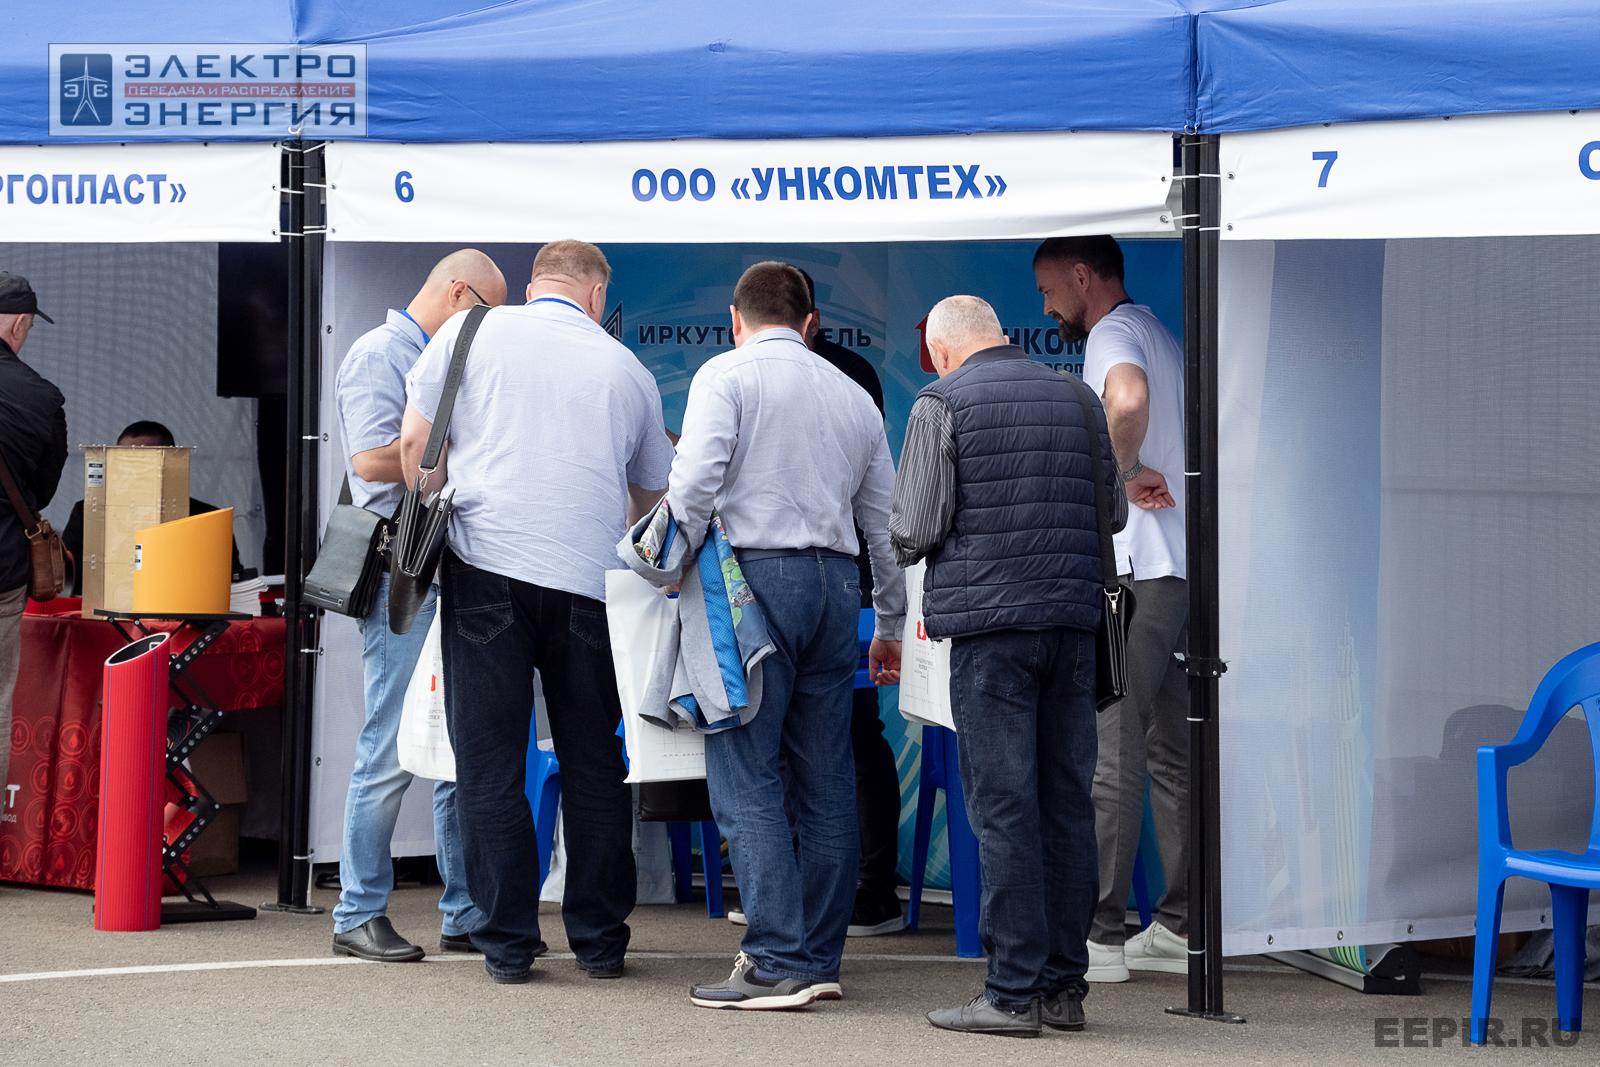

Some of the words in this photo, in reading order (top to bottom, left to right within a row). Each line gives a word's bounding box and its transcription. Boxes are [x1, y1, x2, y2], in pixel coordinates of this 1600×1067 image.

[631, 168, 716, 202] ООО
[731, 164, 1008, 201] «УНКОМТЕХ»
[1312, 151, 1338, 188] 7
[0, 174, 187, 205] ГОПЛАСТ»
[395, 171, 415, 203] 6
